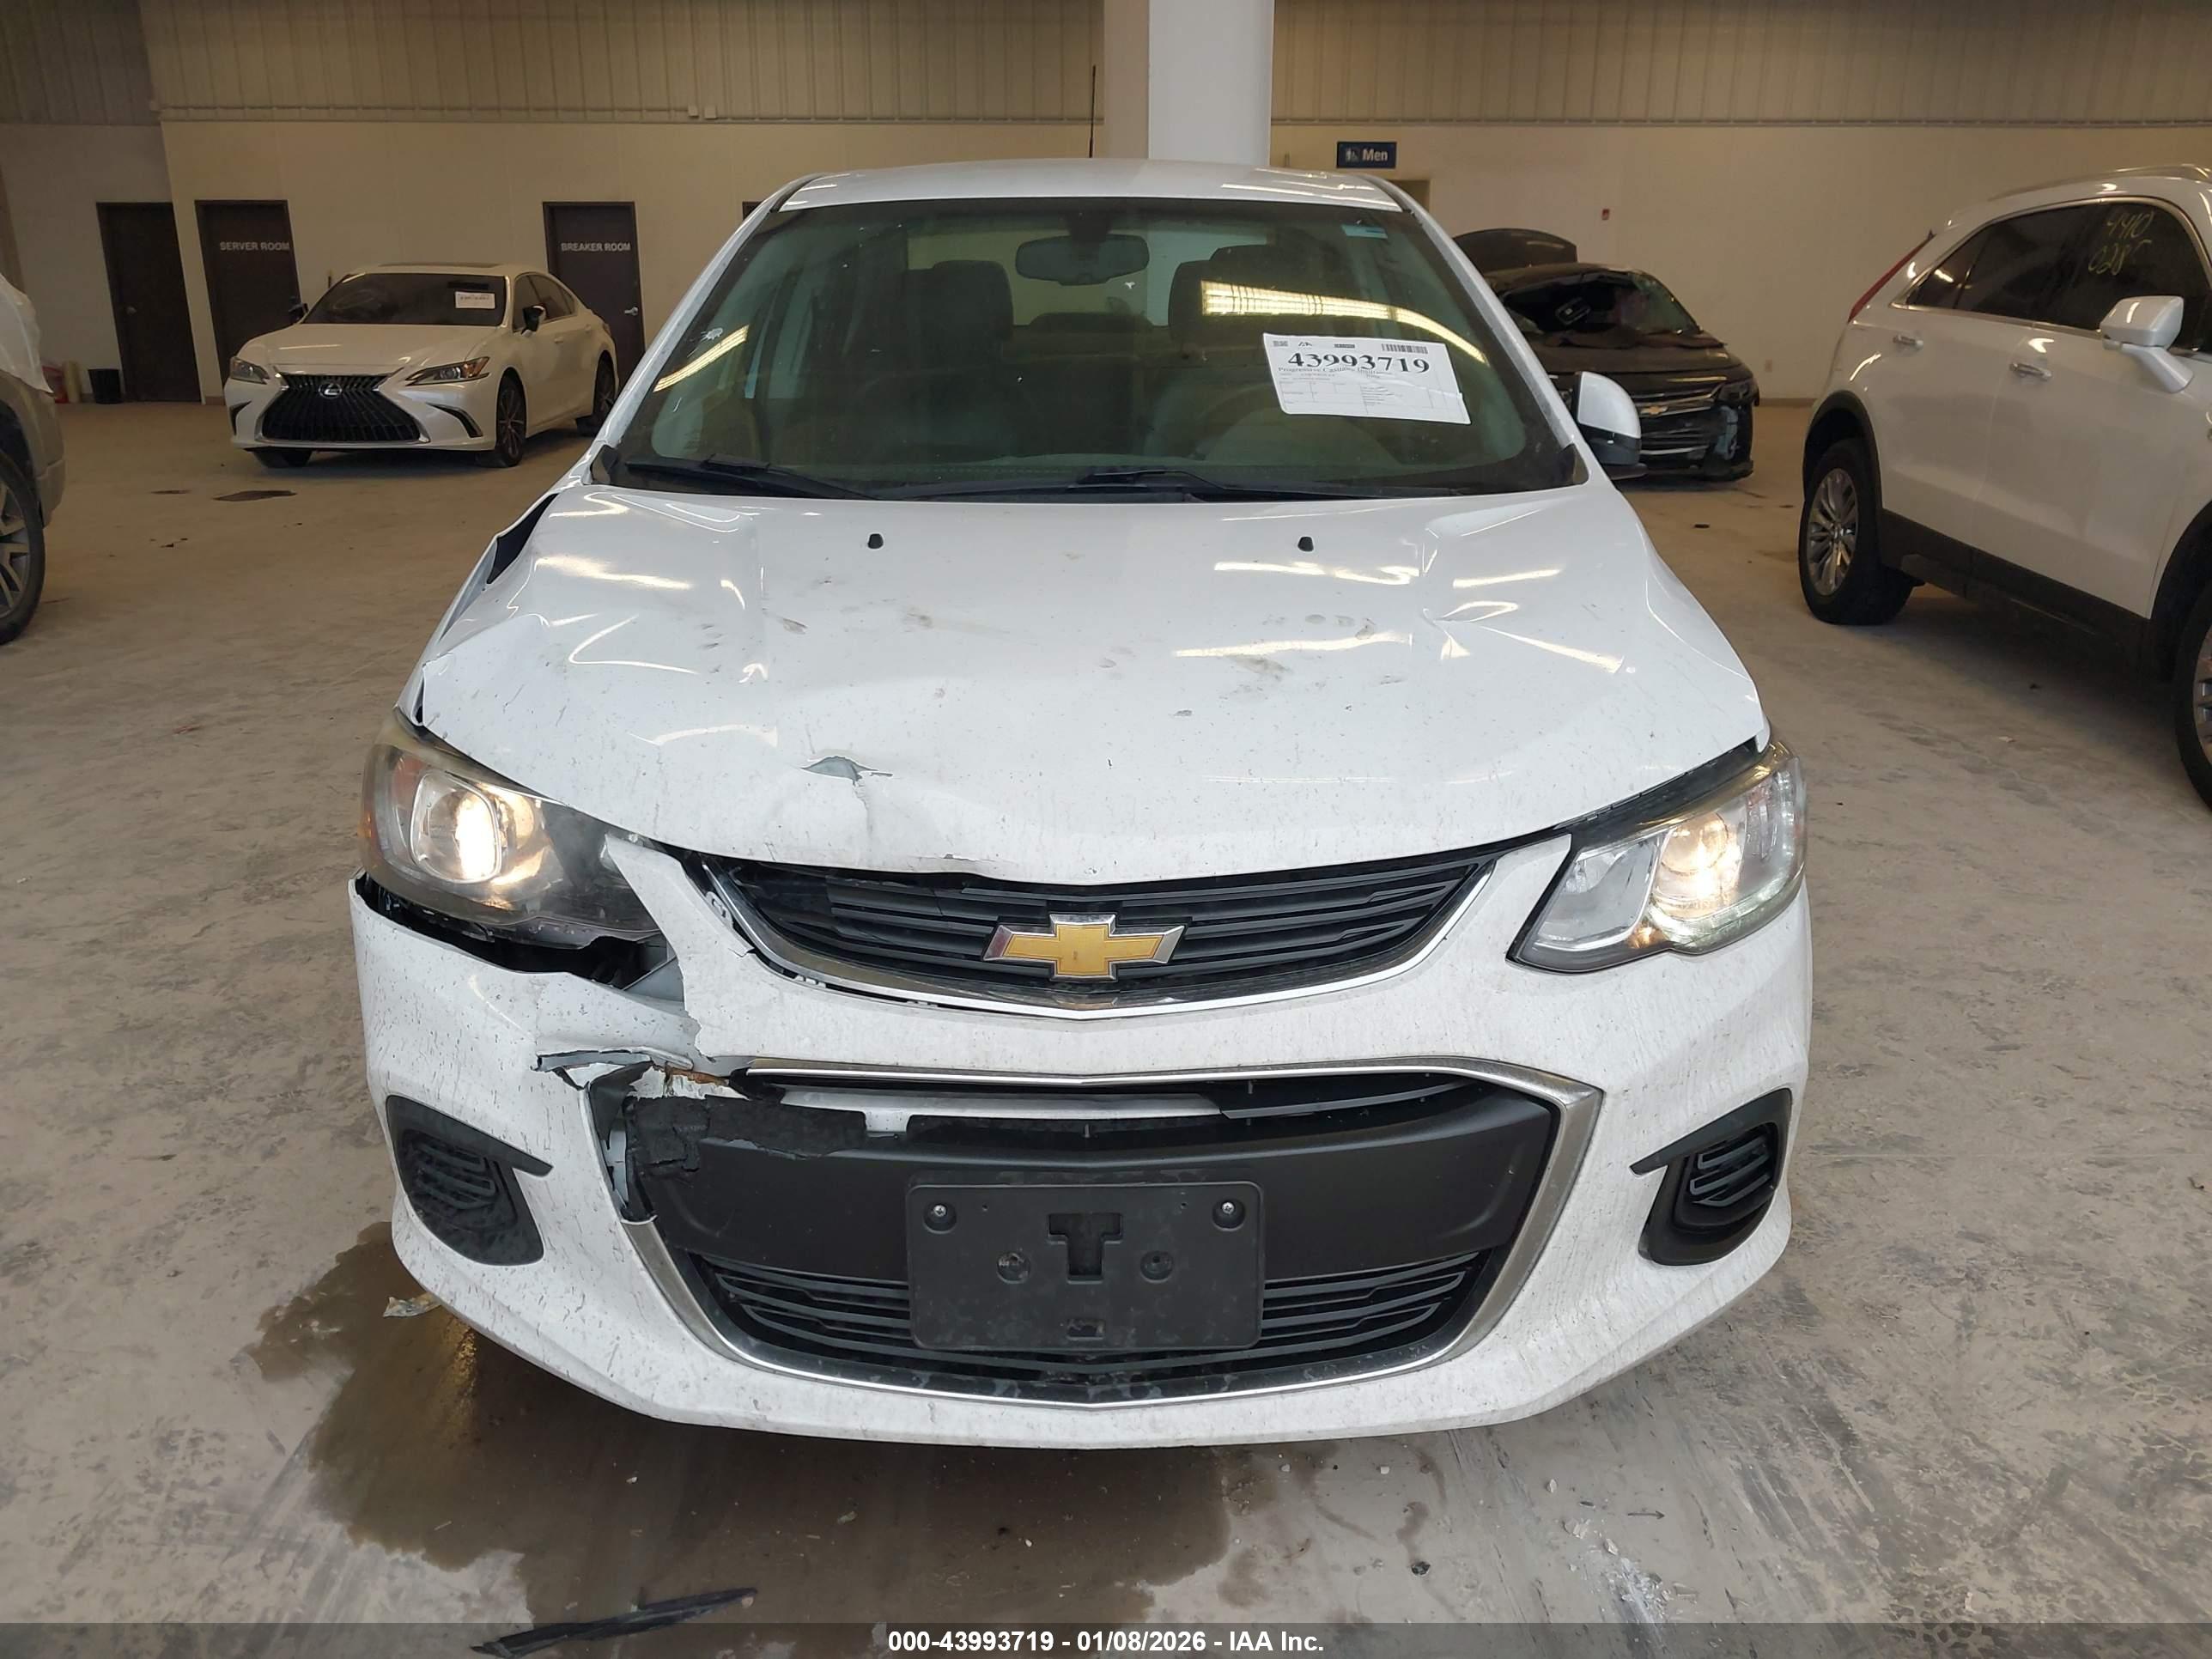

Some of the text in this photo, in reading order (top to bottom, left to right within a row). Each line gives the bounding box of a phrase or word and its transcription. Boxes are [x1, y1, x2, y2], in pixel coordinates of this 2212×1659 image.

[1362, 148, 1389, 161] Men
[220, 241, 290, 251] SERVER ROOM
[561, 242, 631, 252] BREAKER ROOM
[1287, 352, 1431, 374] 43993719
